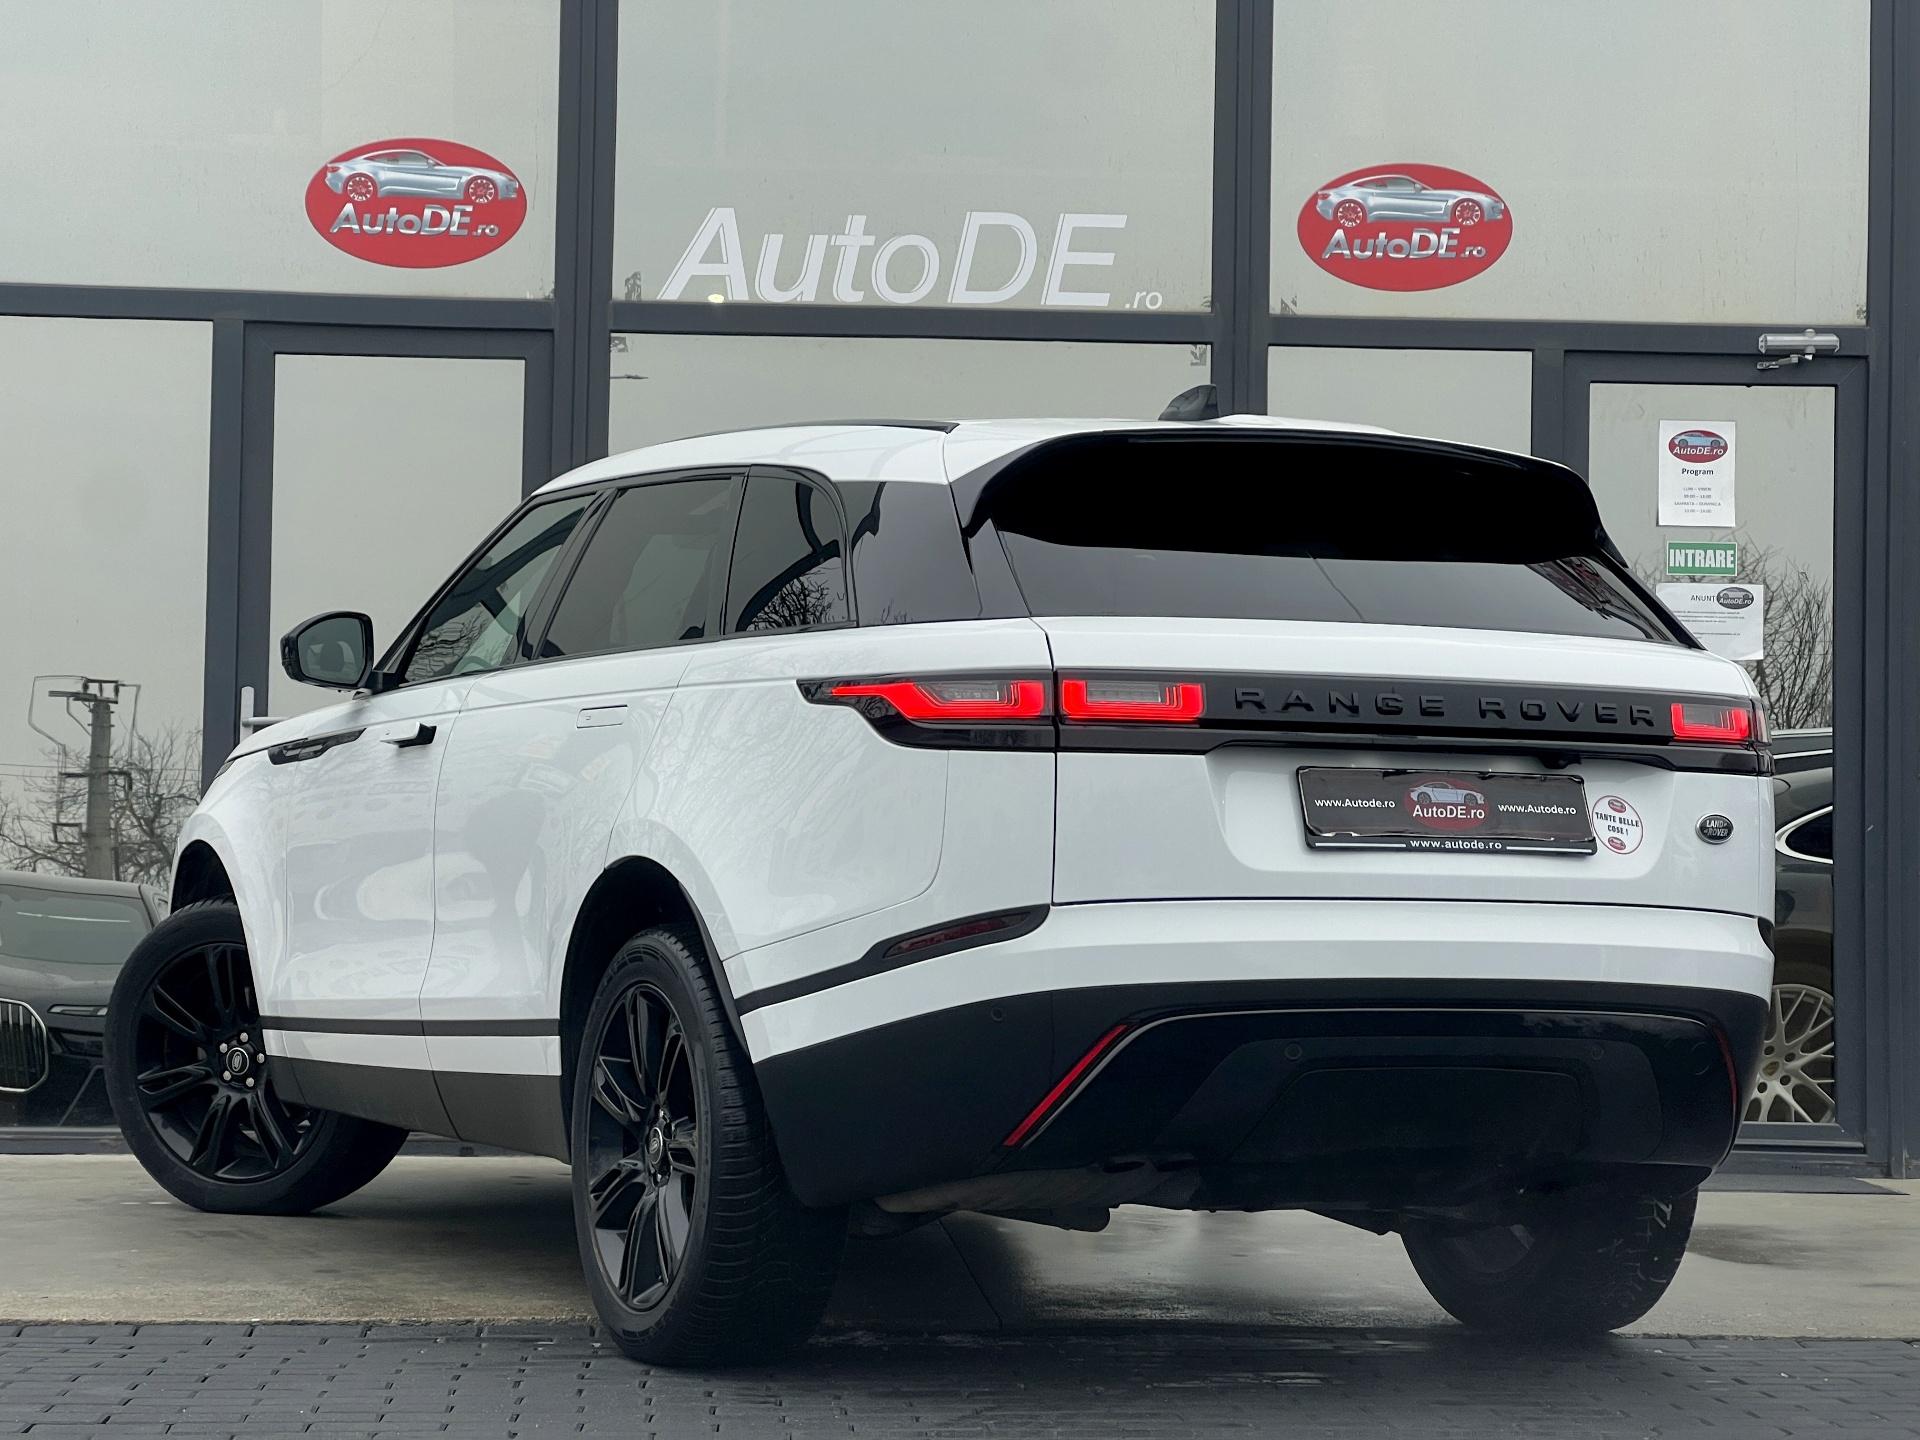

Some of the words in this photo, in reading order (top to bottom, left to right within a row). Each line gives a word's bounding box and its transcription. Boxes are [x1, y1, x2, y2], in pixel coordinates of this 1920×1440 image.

[1673, 446, 1724, 455] AutoDE.ro
[1681, 467, 1714, 477] Program
[1669, 548, 1735, 568] INTRARE
[1234, 687, 1446, 718] RANGE
[1478, 696, 1656, 728] ROVER
[1314, 797, 1396, 809] www.Autode.ro
[1412, 804, 1486, 820] AutoDE.ro
[1497, 803, 1578, 816] www.Autode.ro
[1595, 811, 1617, 823] TANTE
[1618, 817, 1640, 828] BELLE
[1706, 819, 1724, 828] LAND
[1607, 824, 1624, 835] COSE
[1706, 828, 1729, 837] ROVER
[1410, 839, 1503, 851] www.autode.ro
